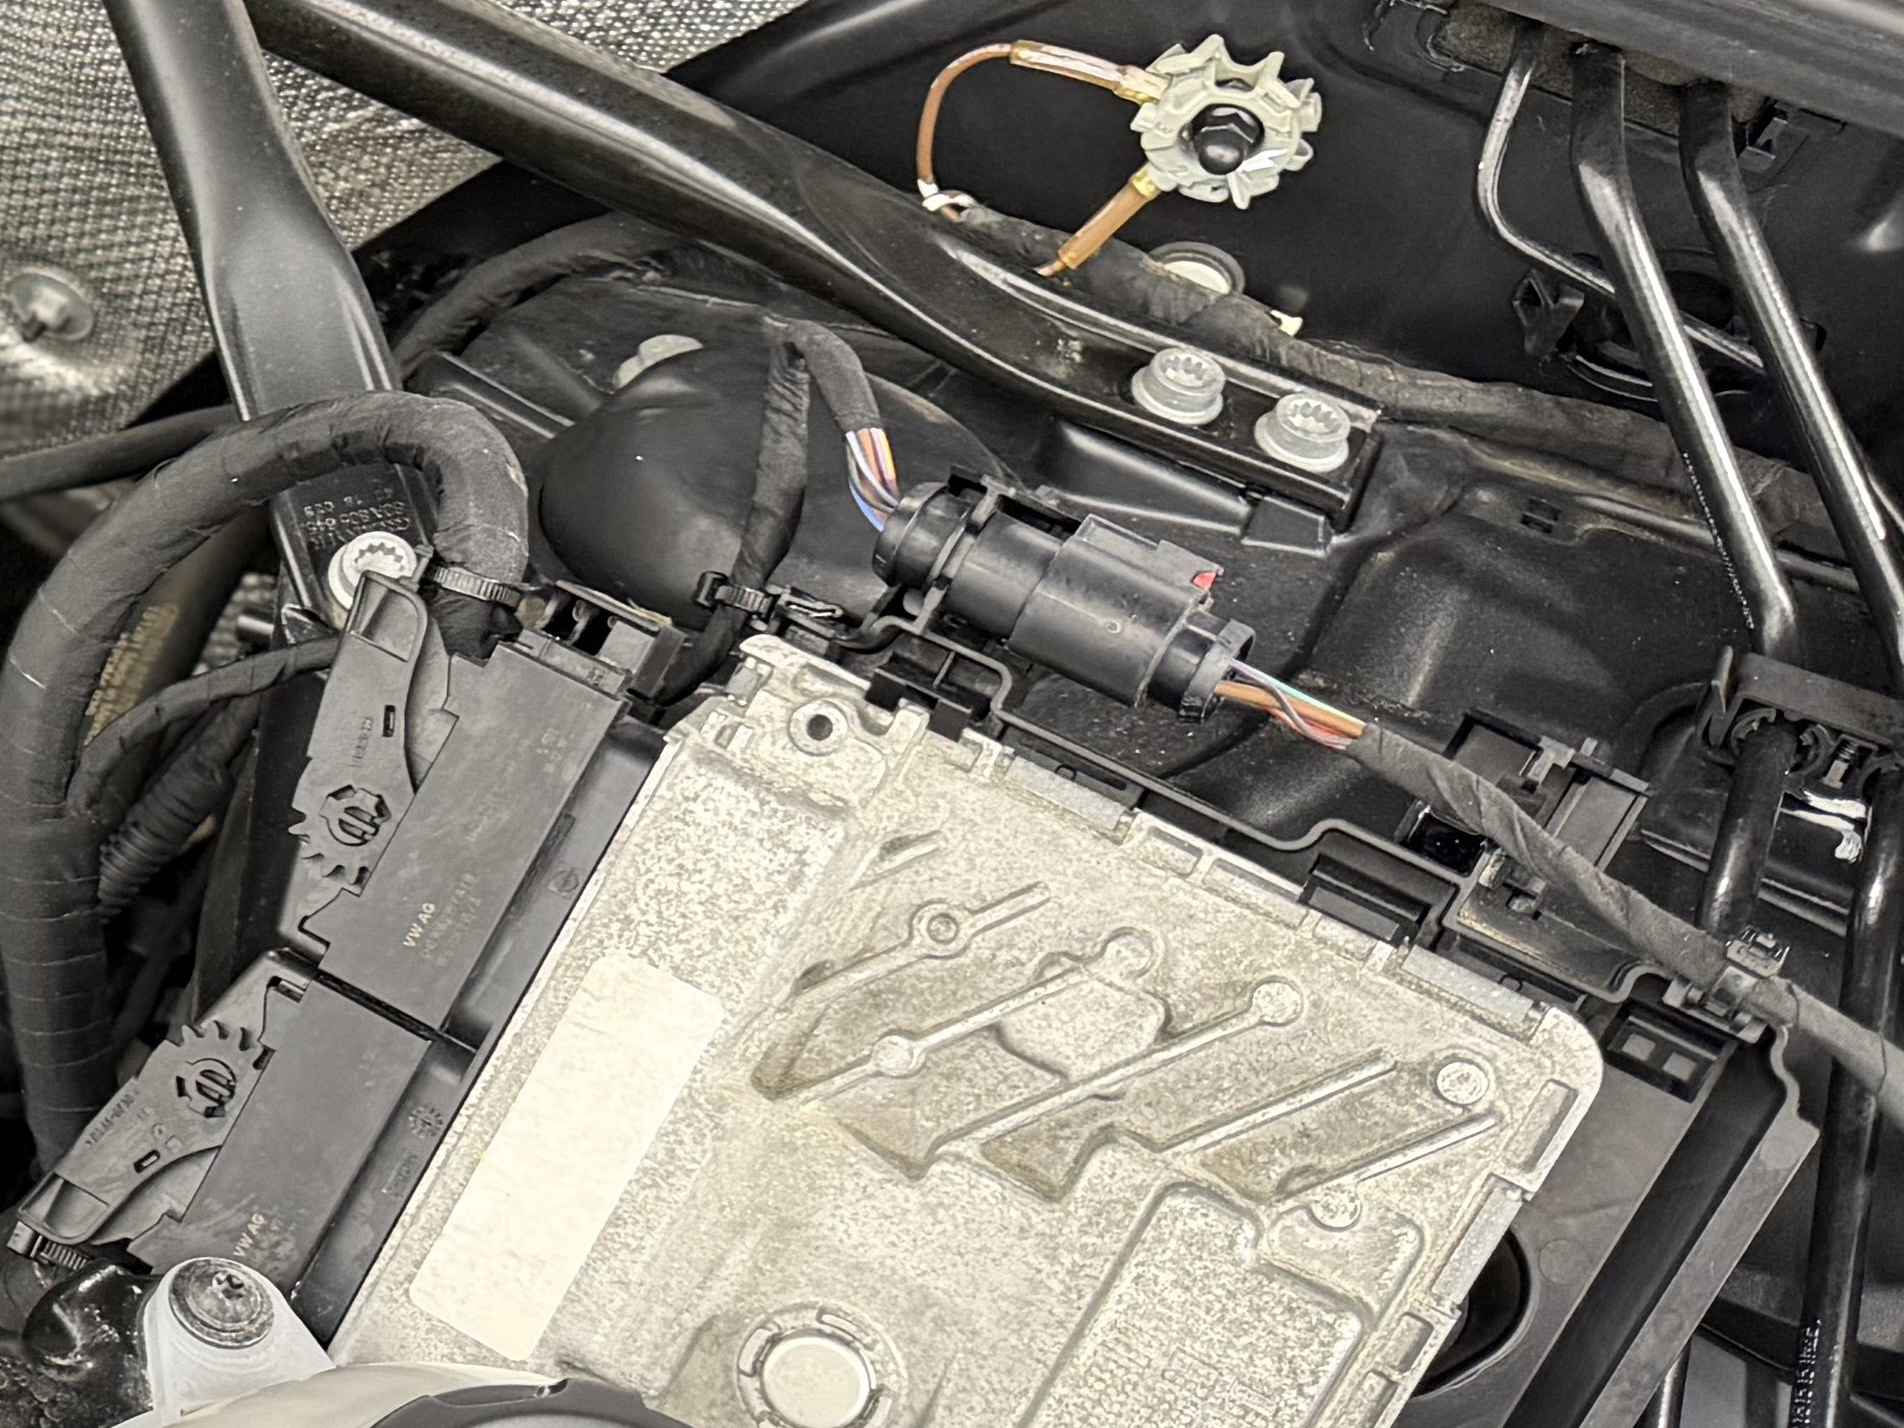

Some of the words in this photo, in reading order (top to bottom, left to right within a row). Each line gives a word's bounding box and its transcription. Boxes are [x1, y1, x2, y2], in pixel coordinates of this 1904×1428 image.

[402, 922, 426, 950] VW
[415, 899, 438, 926] AG
[233, 1232, 255, 1259] VW
[245, 1212, 266, 1235] AG
